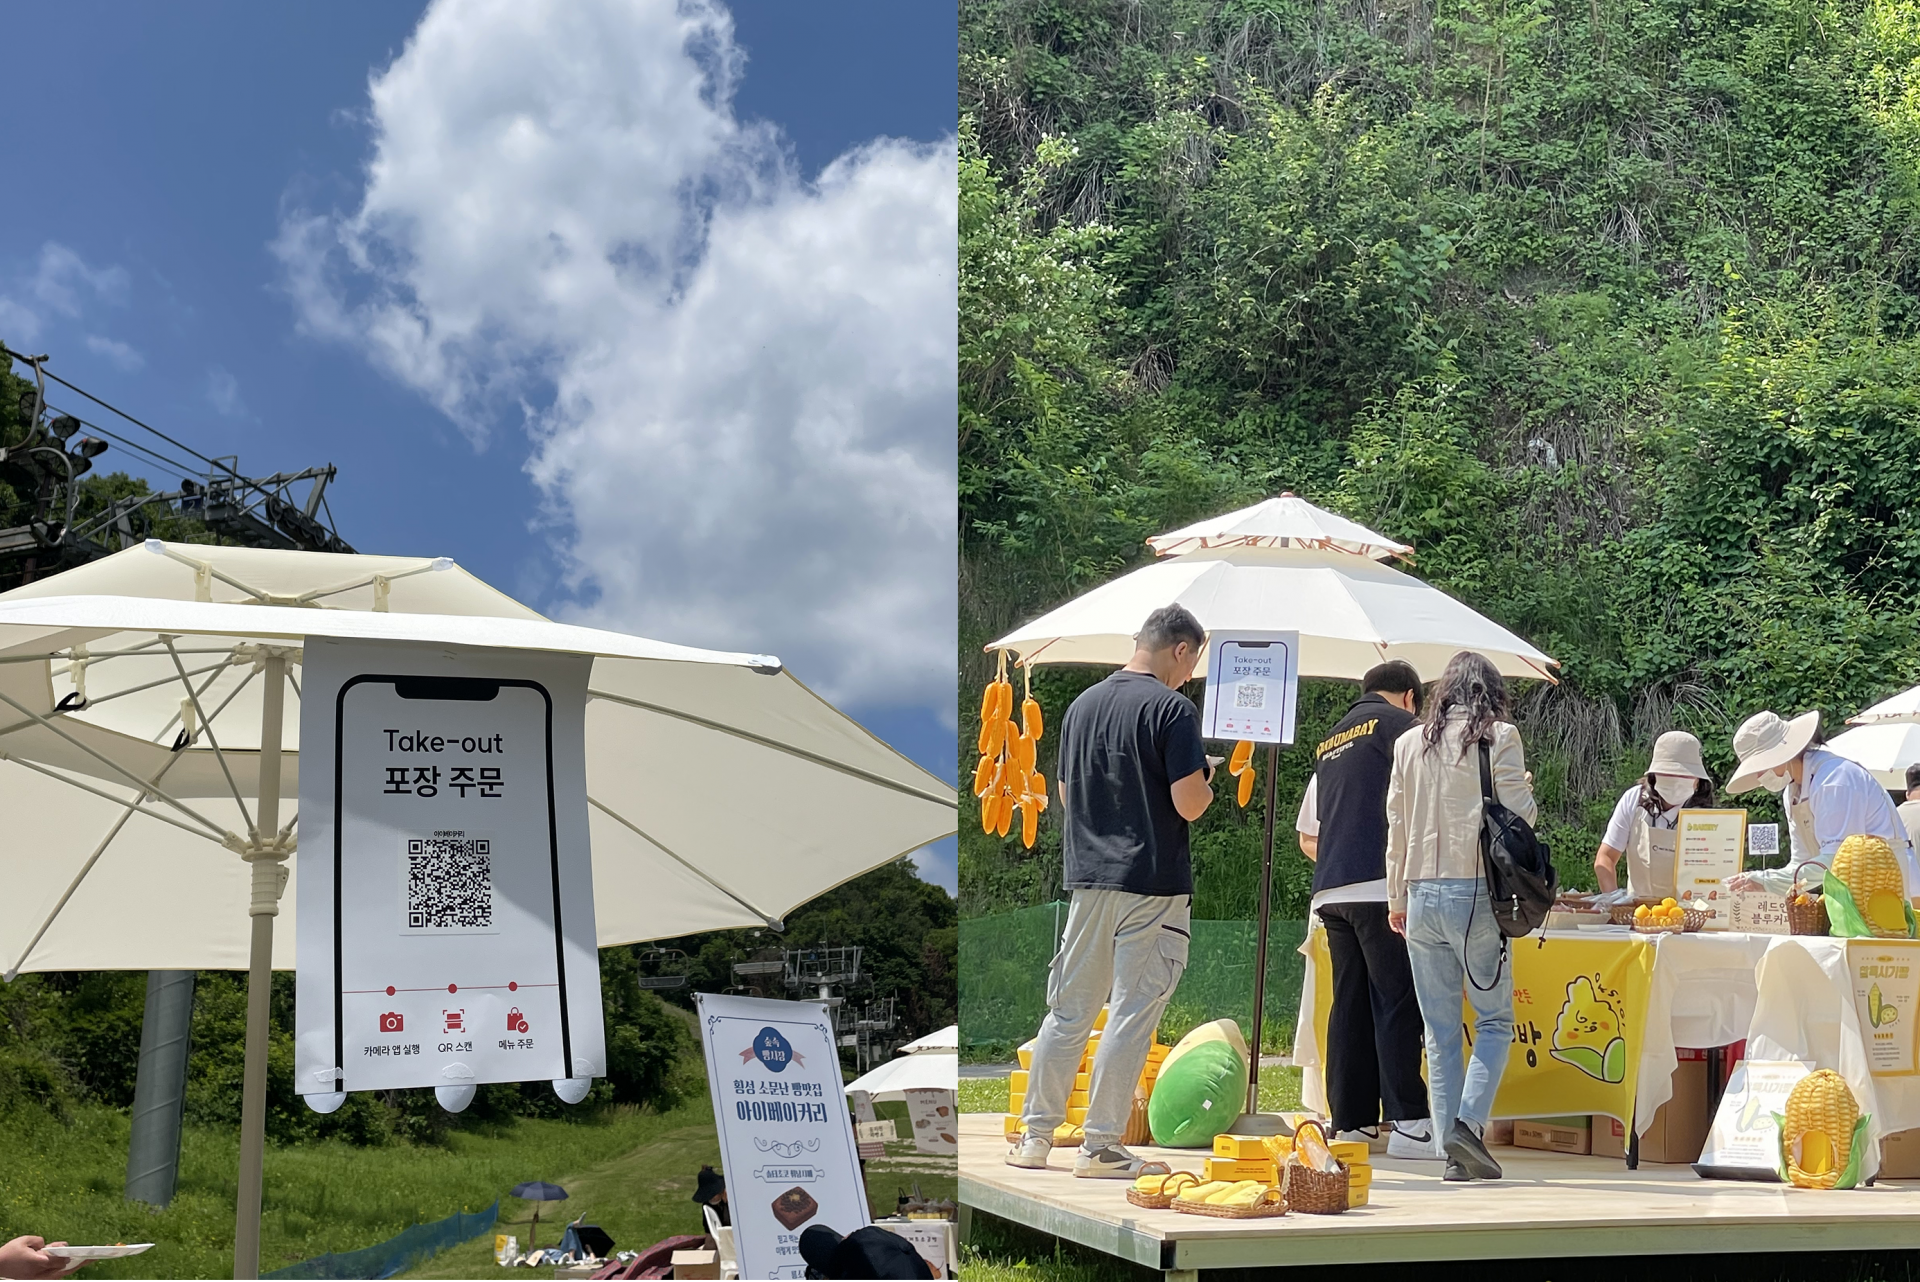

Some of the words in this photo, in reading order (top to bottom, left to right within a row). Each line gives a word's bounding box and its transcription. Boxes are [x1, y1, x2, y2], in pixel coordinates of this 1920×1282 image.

[1233, 656, 1272, 664] Take-out
[1233, 666, 1251, 676] 포장
[1253, 666, 1271, 677] 주문
[383, 729, 504, 754] Take-out
[383, 765, 442, 798] 포장
[448, 766, 504, 798] 주문
[364, 1045, 390, 1057] 카메라
[391, 1044, 401, 1055] 앱
[402, 1044, 420, 1055] 실행
[437, 1042, 453, 1053] QR
[455, 1041, 473, 1053] 스캔
[498, 1039, 516, 1050] 메뉴
[516, 1038, 534, 1049] 주문
[733, 1079, 756, 1095] 횡성
[759, 1080, 790, 1096] 소문난
[791, 1082, 823, 1097] 빵맛집
[736, 1100, 828, 1123] 아이베이커리
